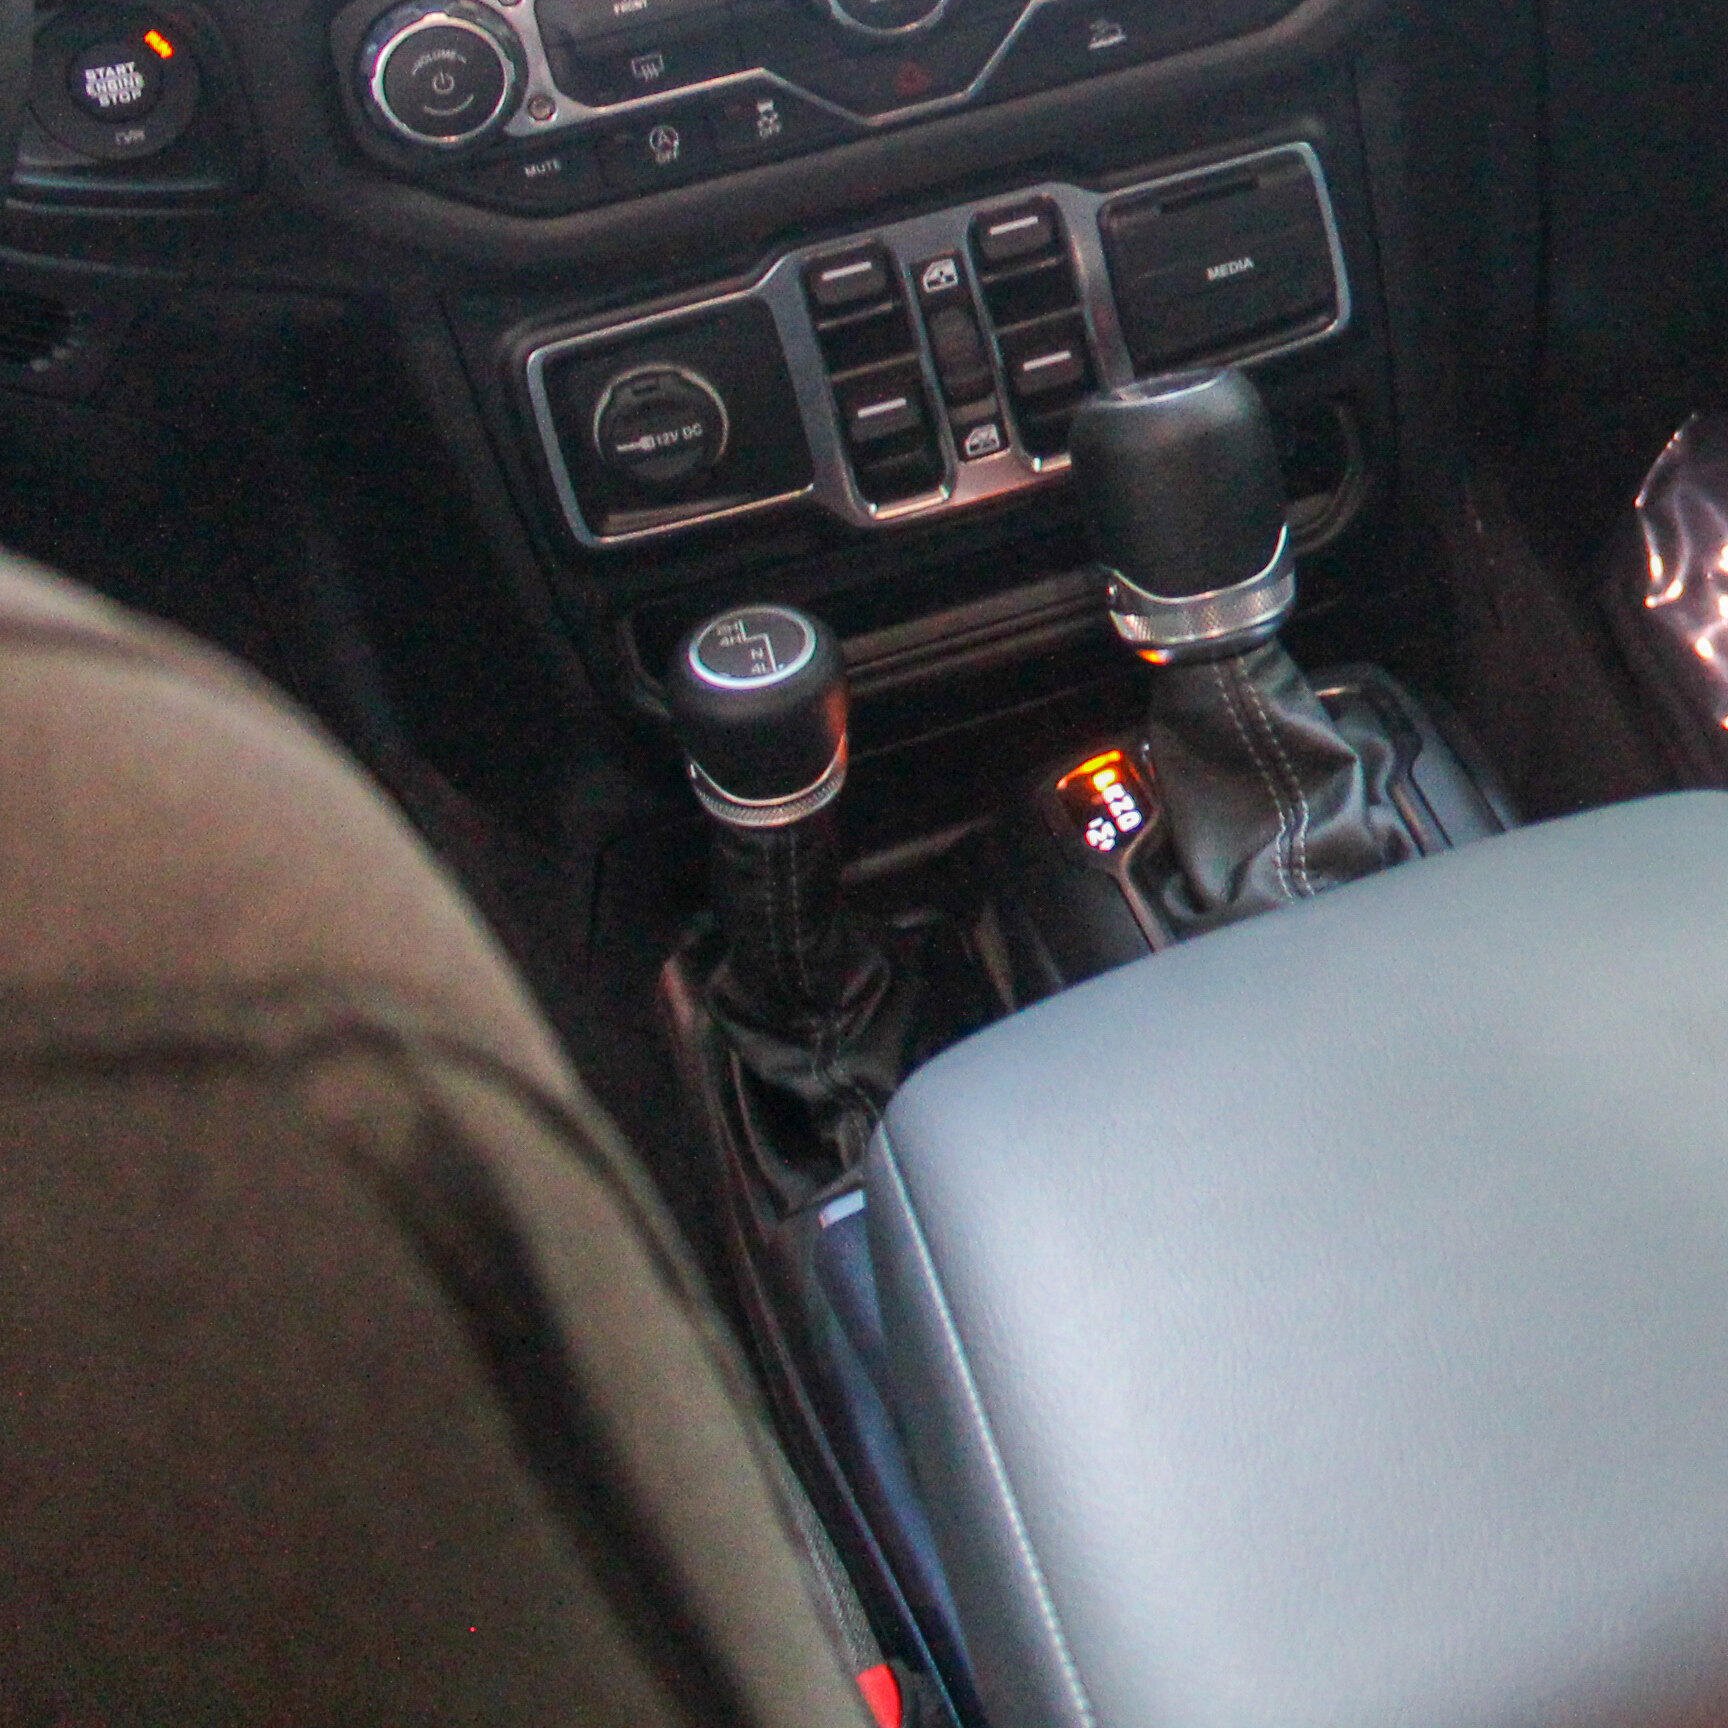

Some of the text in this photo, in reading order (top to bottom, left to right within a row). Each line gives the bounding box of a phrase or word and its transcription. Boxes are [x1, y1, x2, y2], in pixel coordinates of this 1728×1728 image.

[84, 61, 136, 80] START
[85, 72, 145, 98] ENGINE
[98, 90, 142, 108] STOP
[524, 158, 562, 178] MUTE
[1206, 256, 1255, 281] MEDIA
[750, 647, 764, 660] N
